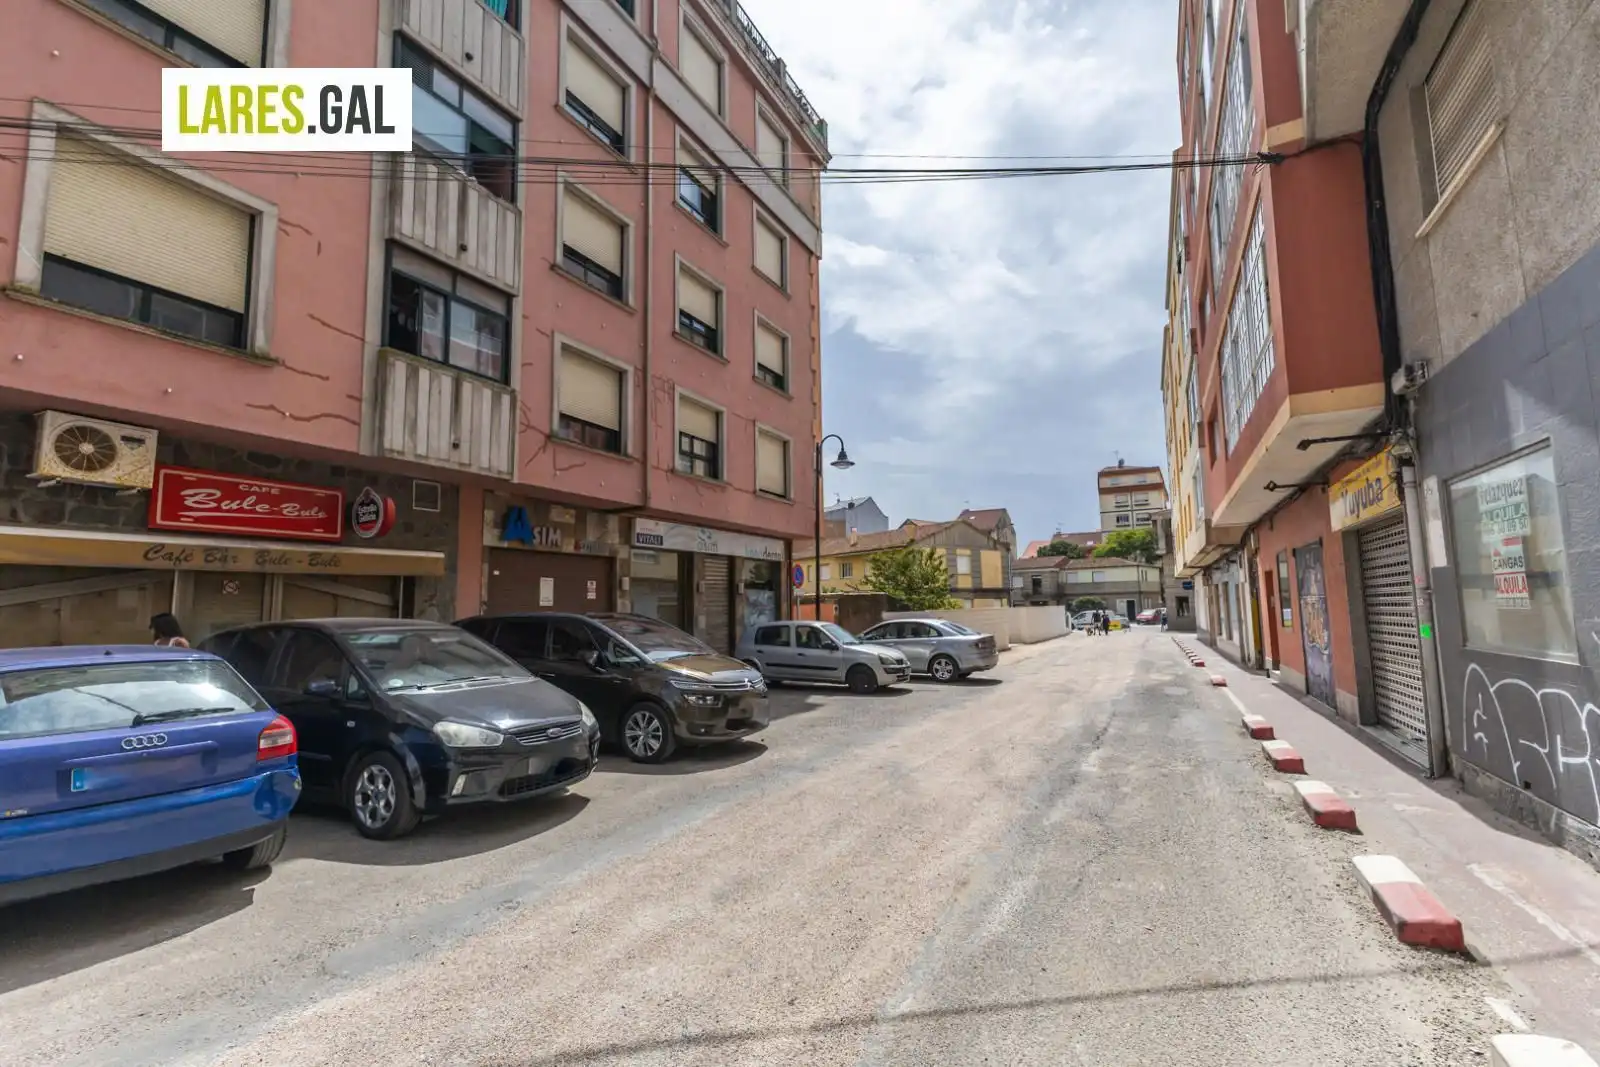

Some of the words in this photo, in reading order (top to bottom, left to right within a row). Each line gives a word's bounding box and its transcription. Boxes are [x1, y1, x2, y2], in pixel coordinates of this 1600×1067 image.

[239, 484, 281, 495] CAFE
[179, 488, 328, 517] Bule-Bule
[1483, 502, 1527, 523] ALQUILA
[143, 542, 193, 566] Café
[1493, 556, 1523, 570] CANGAS
[1495, 575, 1528, 594] ALQUILA
